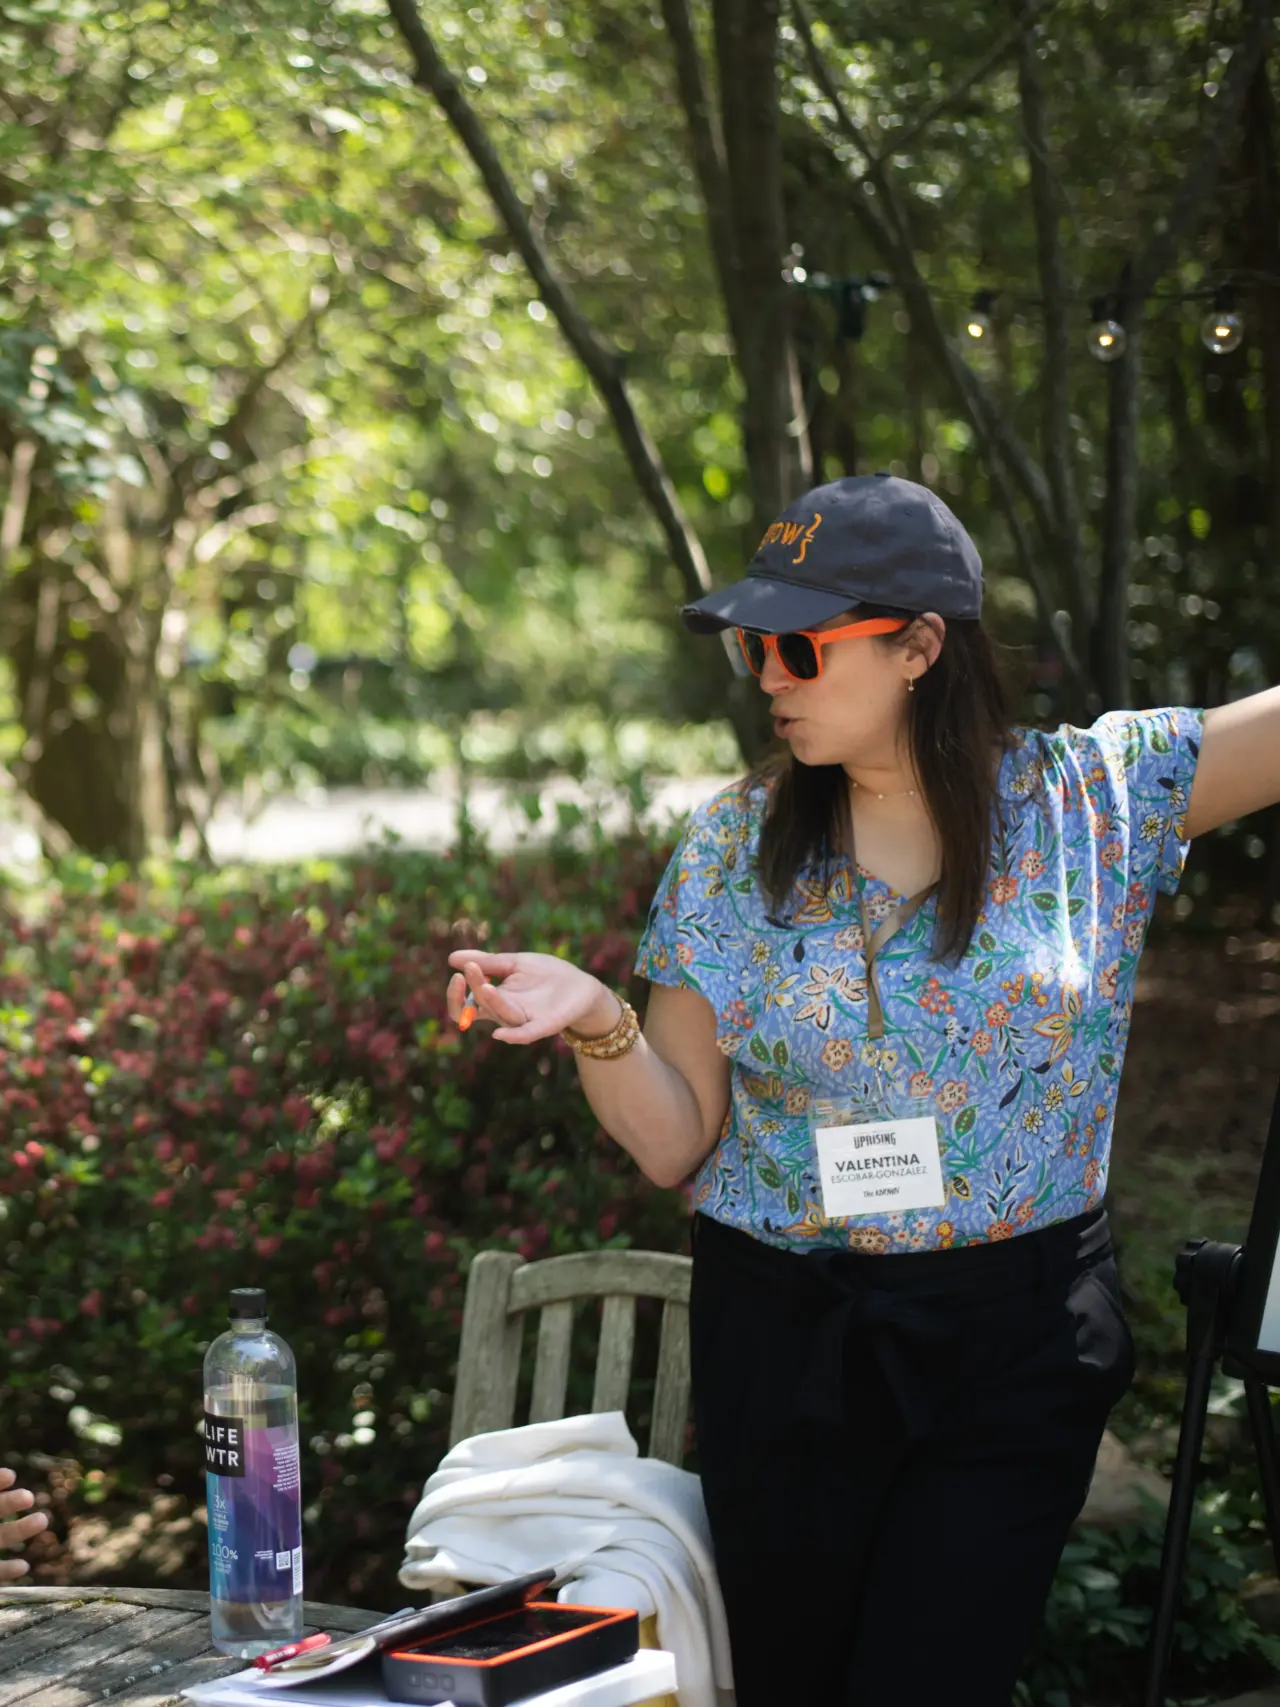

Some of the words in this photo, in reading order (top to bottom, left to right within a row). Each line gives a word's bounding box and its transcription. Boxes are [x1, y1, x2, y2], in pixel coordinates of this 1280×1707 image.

[853, 1132, 896, 1149] UPRISING
[835, 1153, 920, 1173] VALENTINA
[205, 1423, 238, 1444] LIFE
[206, 1444, 239, 1467] WTR
[212, 1543, 238, 1560] 100%
